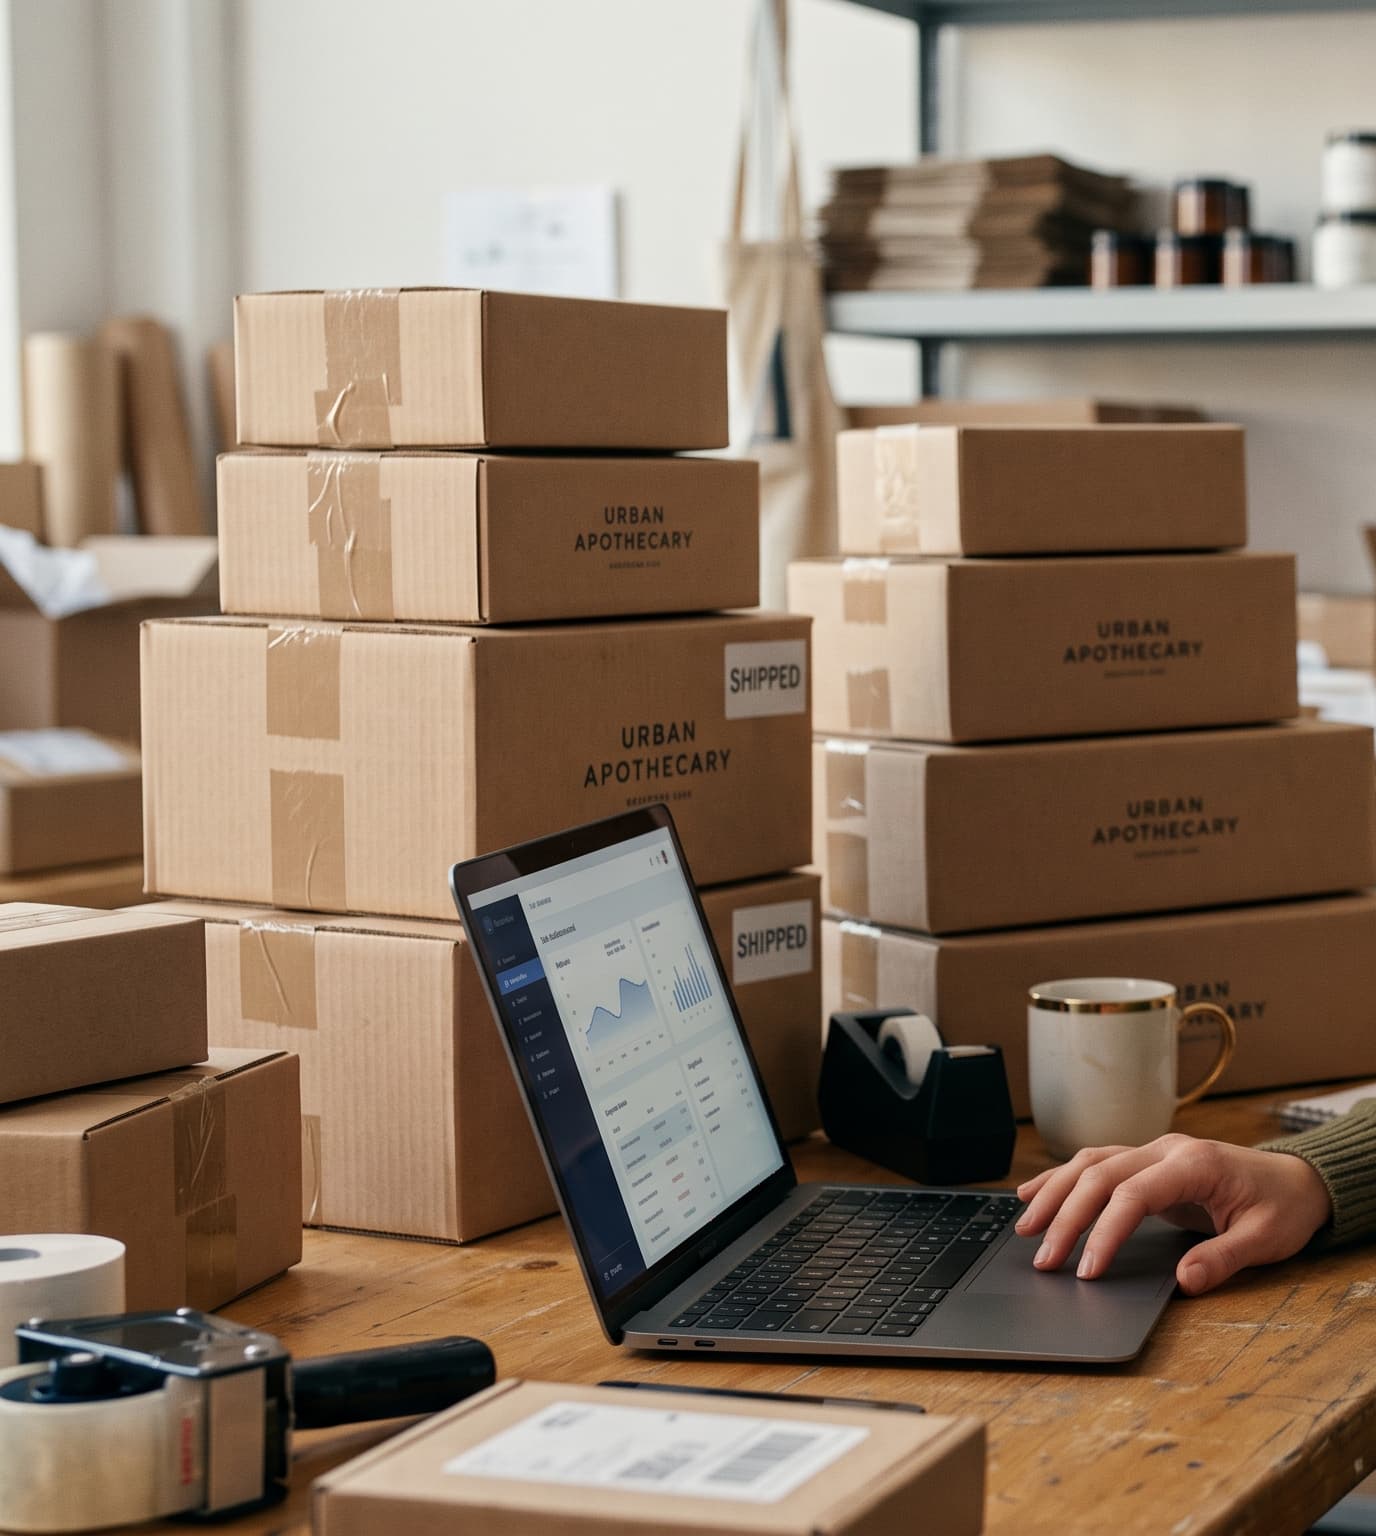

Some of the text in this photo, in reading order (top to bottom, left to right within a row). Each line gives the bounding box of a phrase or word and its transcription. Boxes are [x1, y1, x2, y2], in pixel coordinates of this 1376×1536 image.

[604, 505, 664, 525] URBAN
[574, 531, 693, 552] APOTHECARY
[1097, 619, 1169, 639] URBAN
[1063, 640, 1203, 664] APOTHECARY
[730, 664, 801, 694] SHIPPED
[621, 719, 696, 749] URBAN
[584, 748, 731, 788] APOTHECARY
[1126, 797, 1204, 820] URBAN
[1093, 815, 1239, 845] APOTHECARY
[737, 924, 807, 959] SHIPPED
